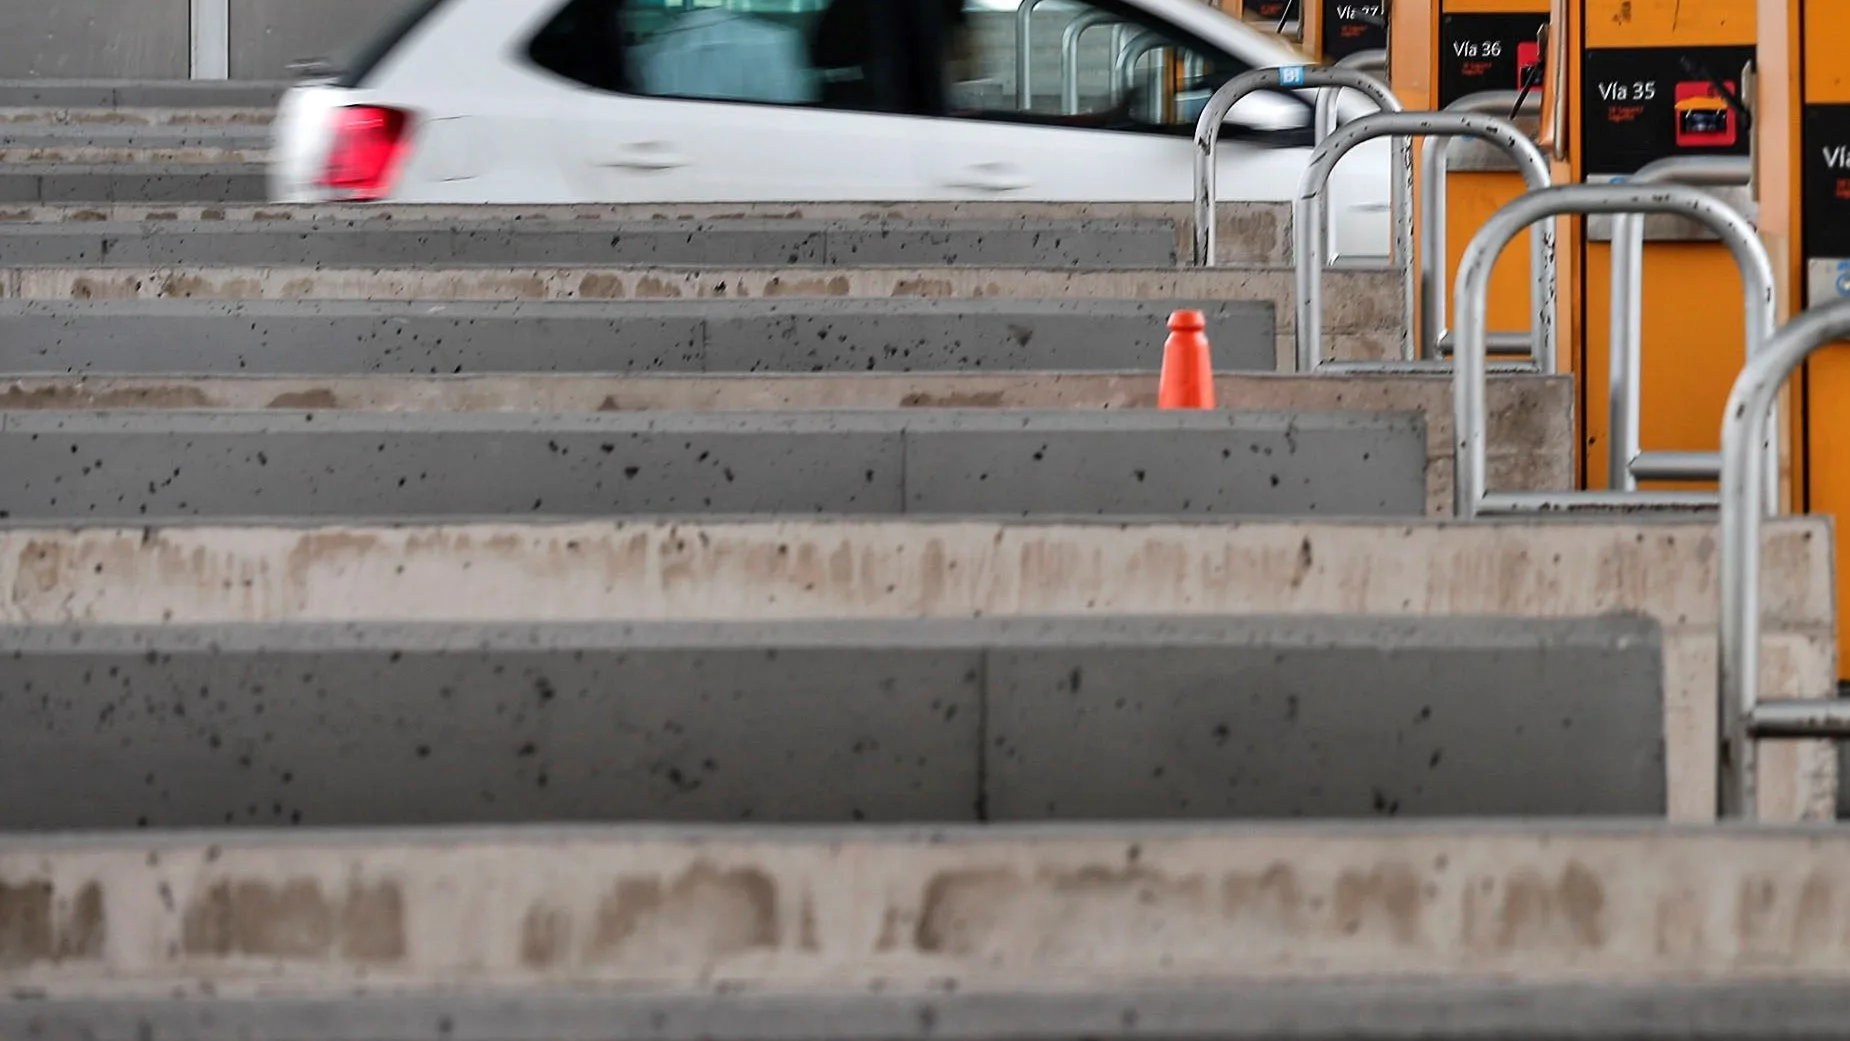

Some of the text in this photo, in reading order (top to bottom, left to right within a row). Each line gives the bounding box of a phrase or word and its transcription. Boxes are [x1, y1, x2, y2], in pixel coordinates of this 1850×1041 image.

[1453, 40, 1502, 57] Vía 36
[1598, 81, 1656, 101] Vía 35
